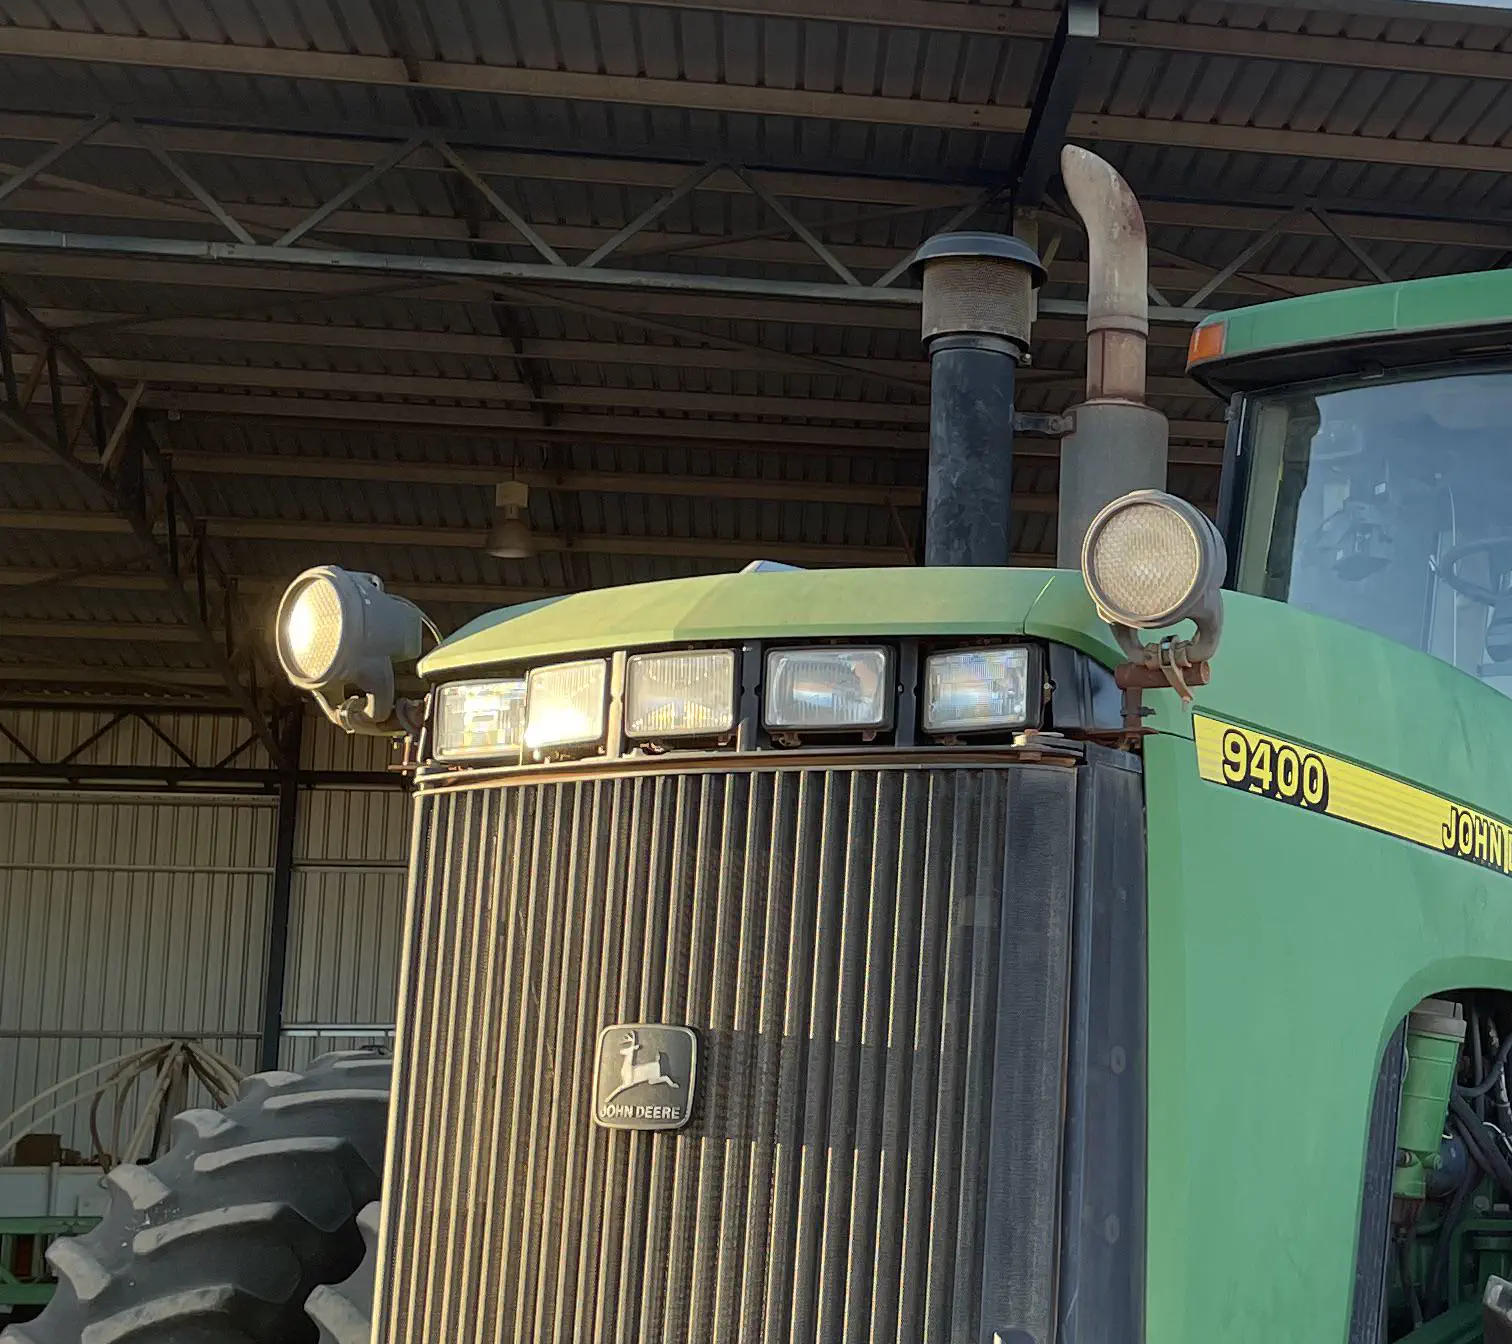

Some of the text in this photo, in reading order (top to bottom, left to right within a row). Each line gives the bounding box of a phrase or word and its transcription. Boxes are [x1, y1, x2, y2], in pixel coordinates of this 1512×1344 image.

[1222, 729, 1328, 809] 9400
[1442, 806, 1503, 868] JOHN
[600, 1104, 681, 1119] JOHN DEERE
